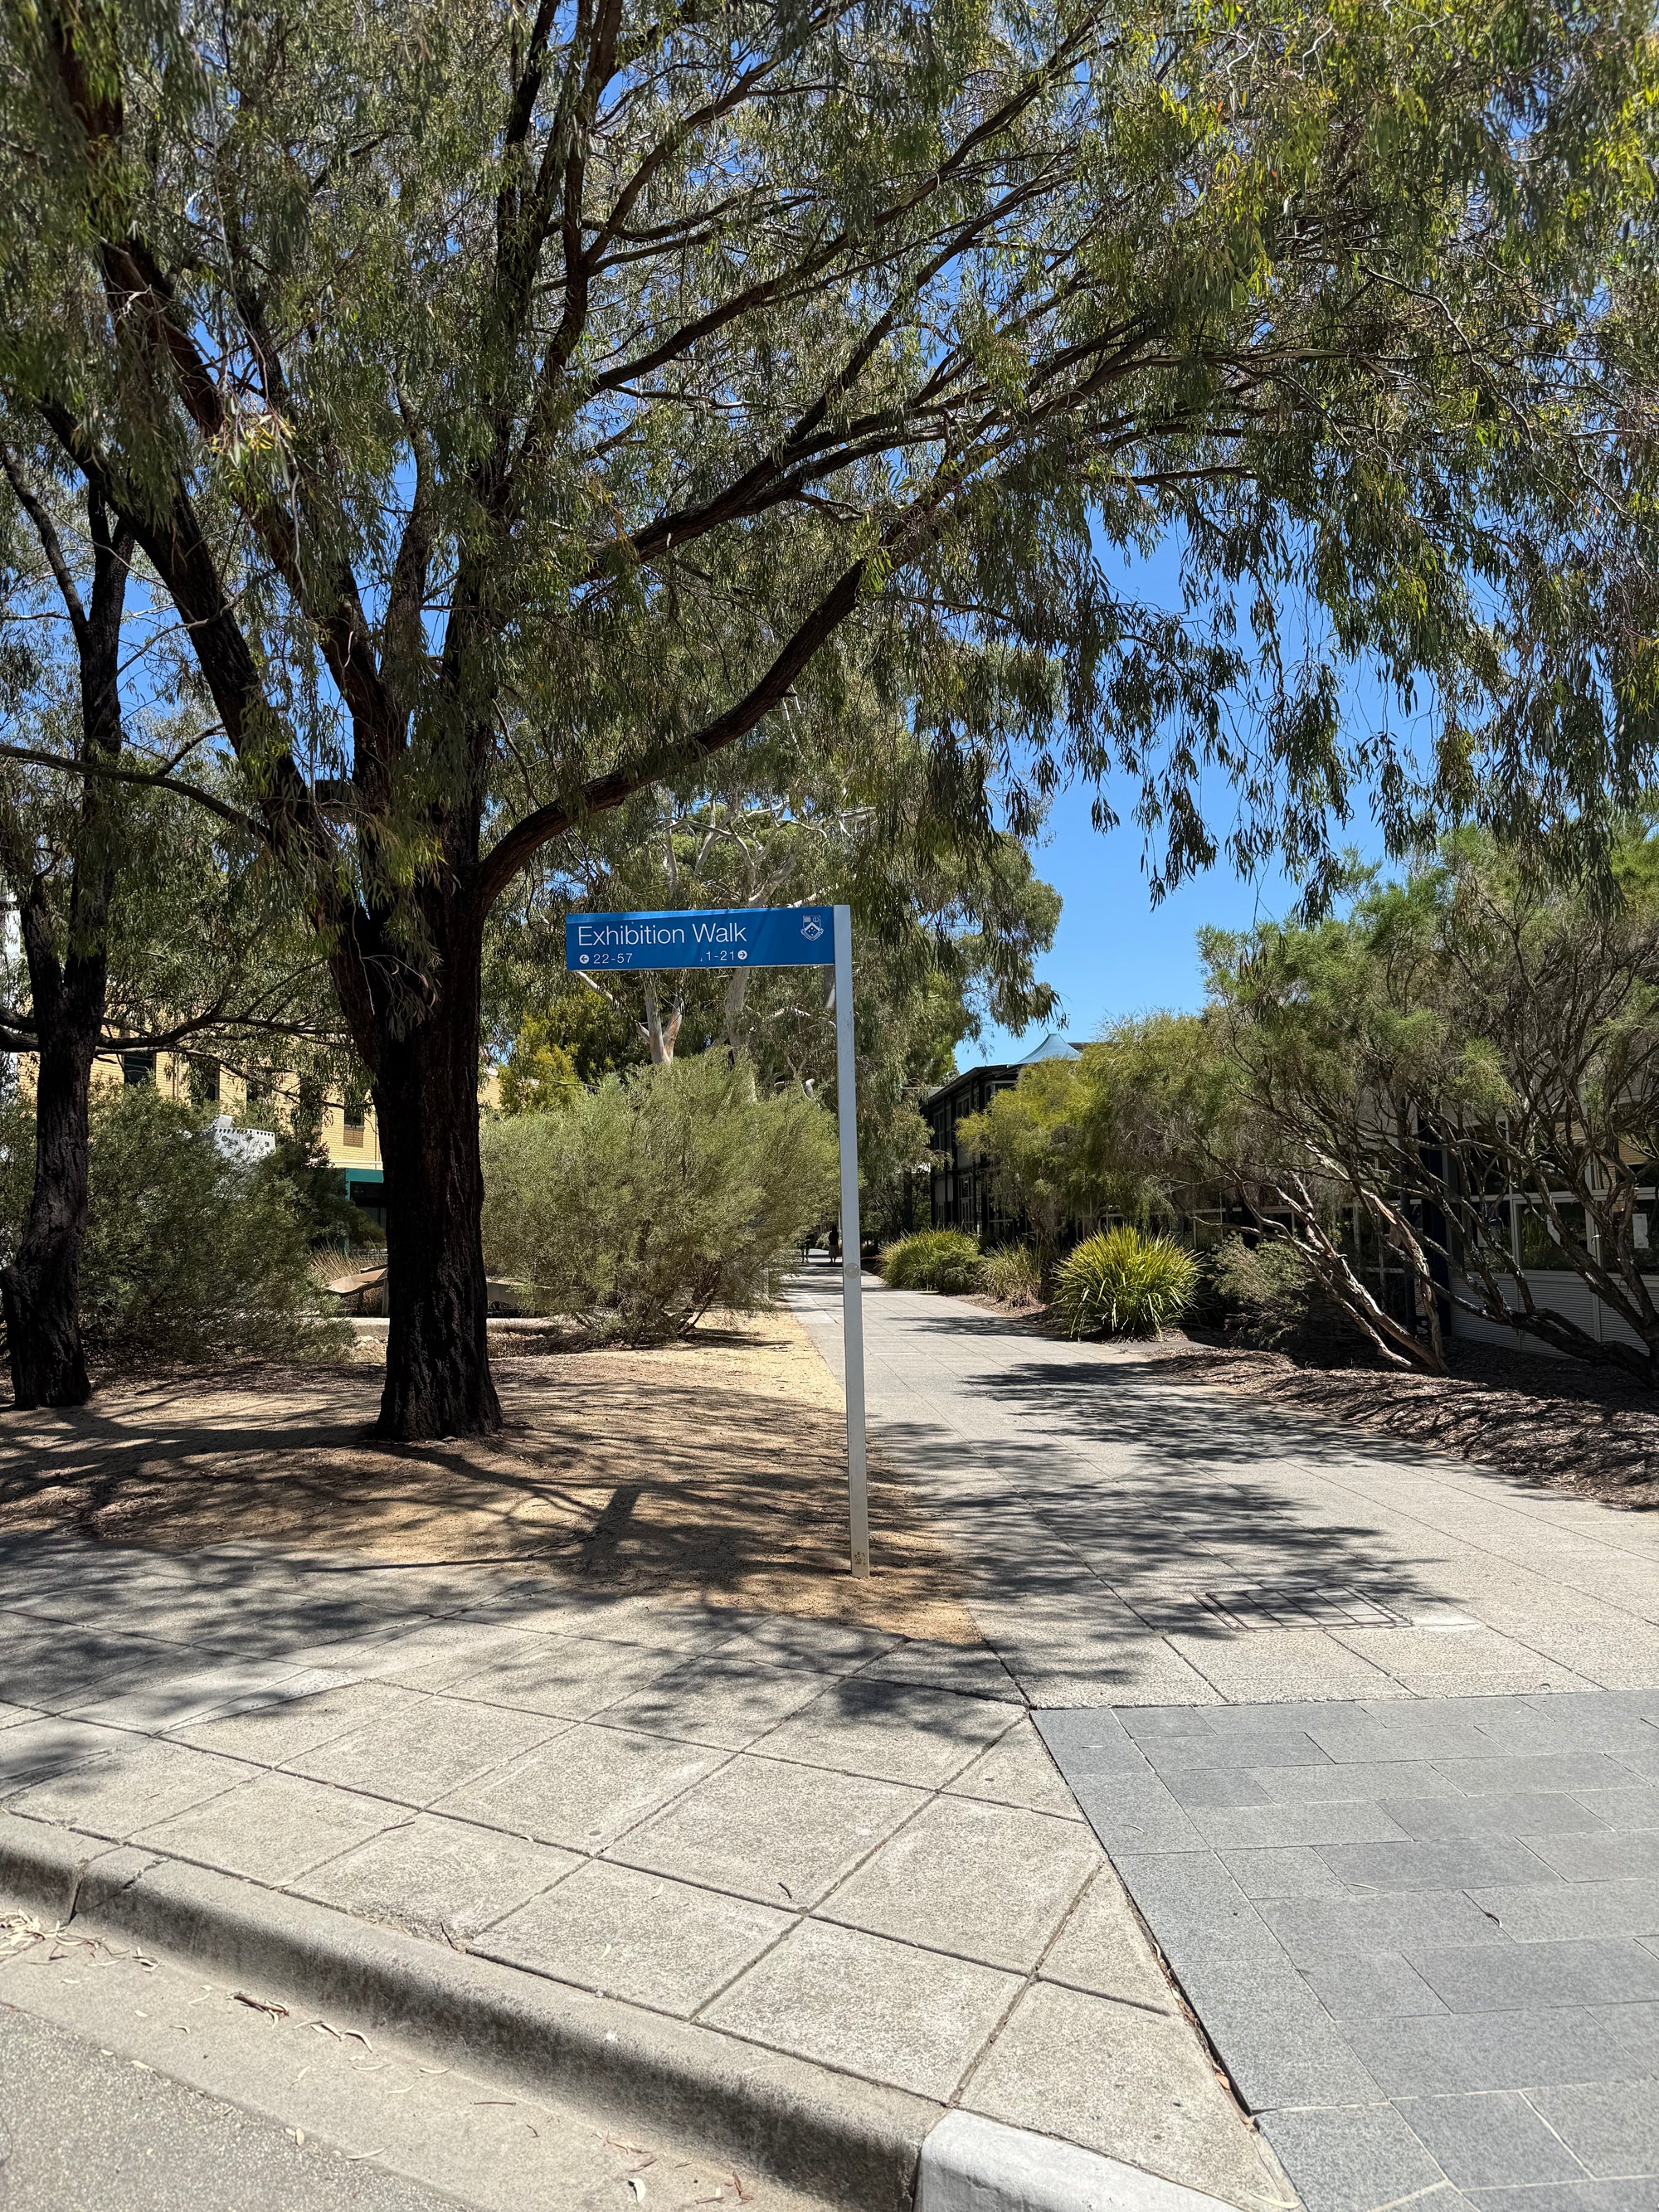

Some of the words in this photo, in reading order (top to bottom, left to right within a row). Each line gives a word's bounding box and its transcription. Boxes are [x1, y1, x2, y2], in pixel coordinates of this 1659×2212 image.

[578, 924, 685, 946] Exhibition
[692, 922, 747, 943] Walk
[593, 952, 633, 965] 22-57
[706, 950, 734, 961] 1-21
